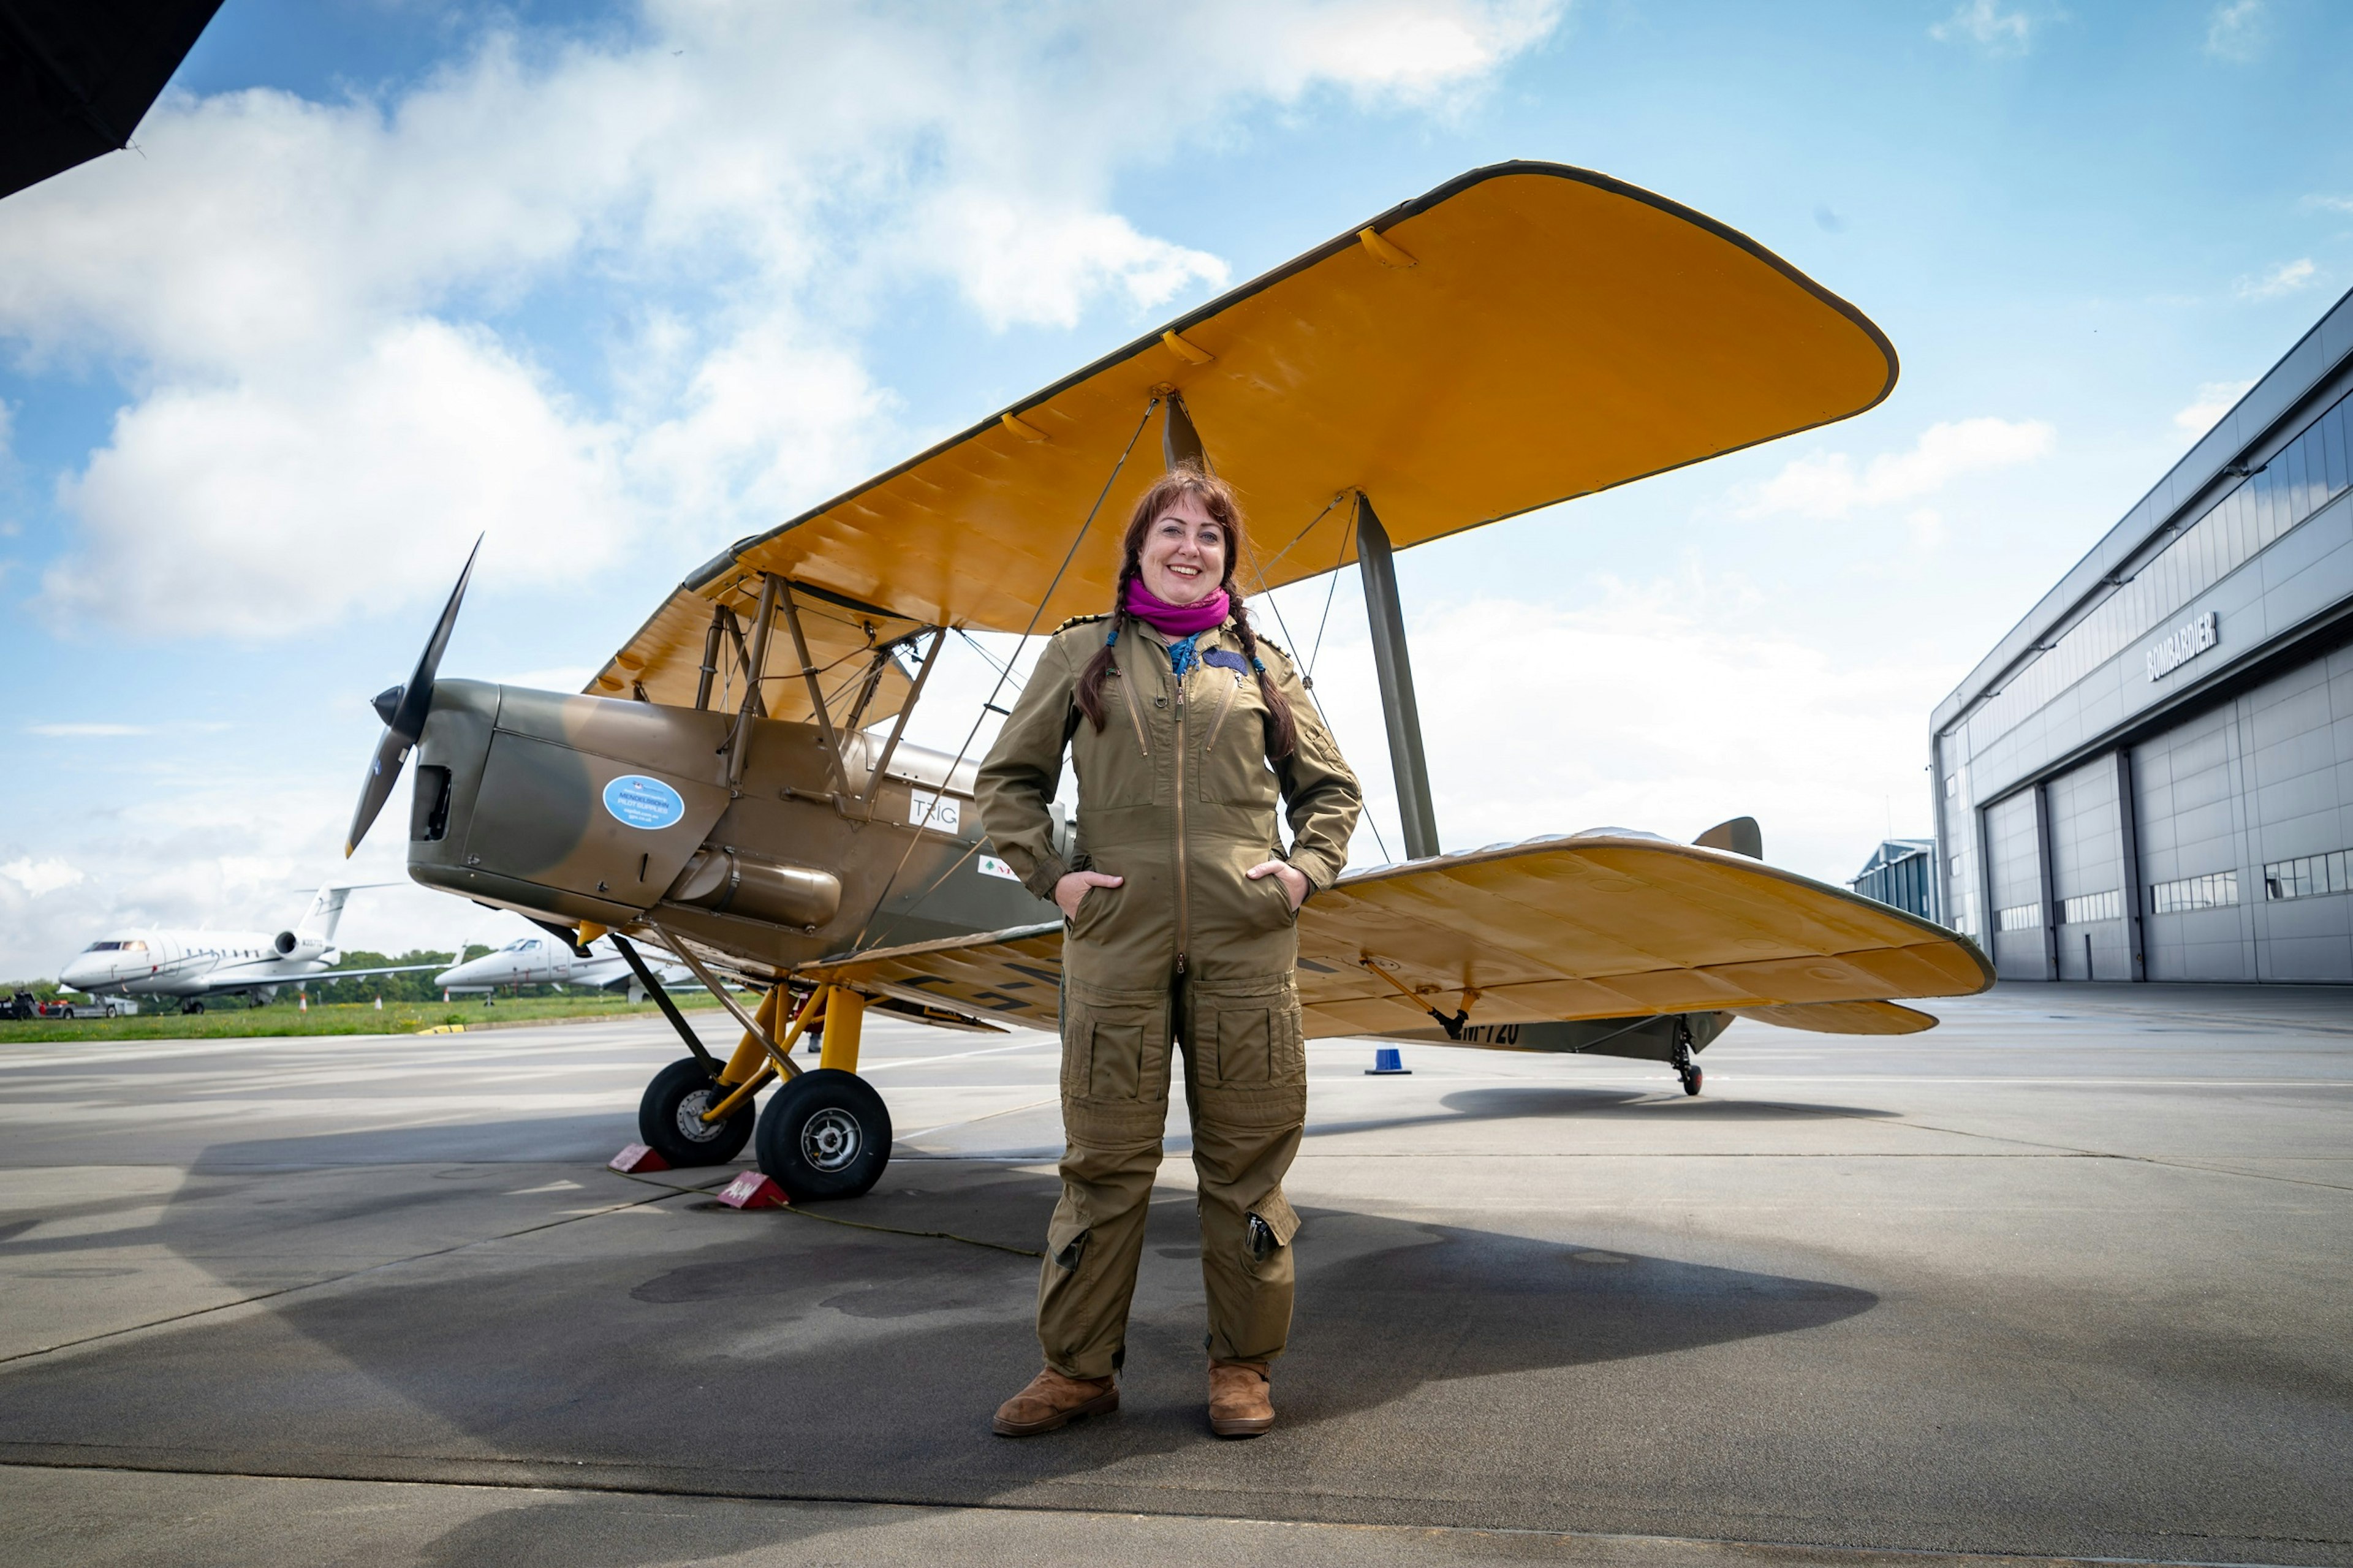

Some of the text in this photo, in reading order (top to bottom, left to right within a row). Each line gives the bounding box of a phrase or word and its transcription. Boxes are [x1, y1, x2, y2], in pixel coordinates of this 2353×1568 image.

[2146, 611, 2218, 683] BOMBARDIER
[618, 798, 636, 807] PILOT
[619, 792, 669, 808] MENDELSSOHN
